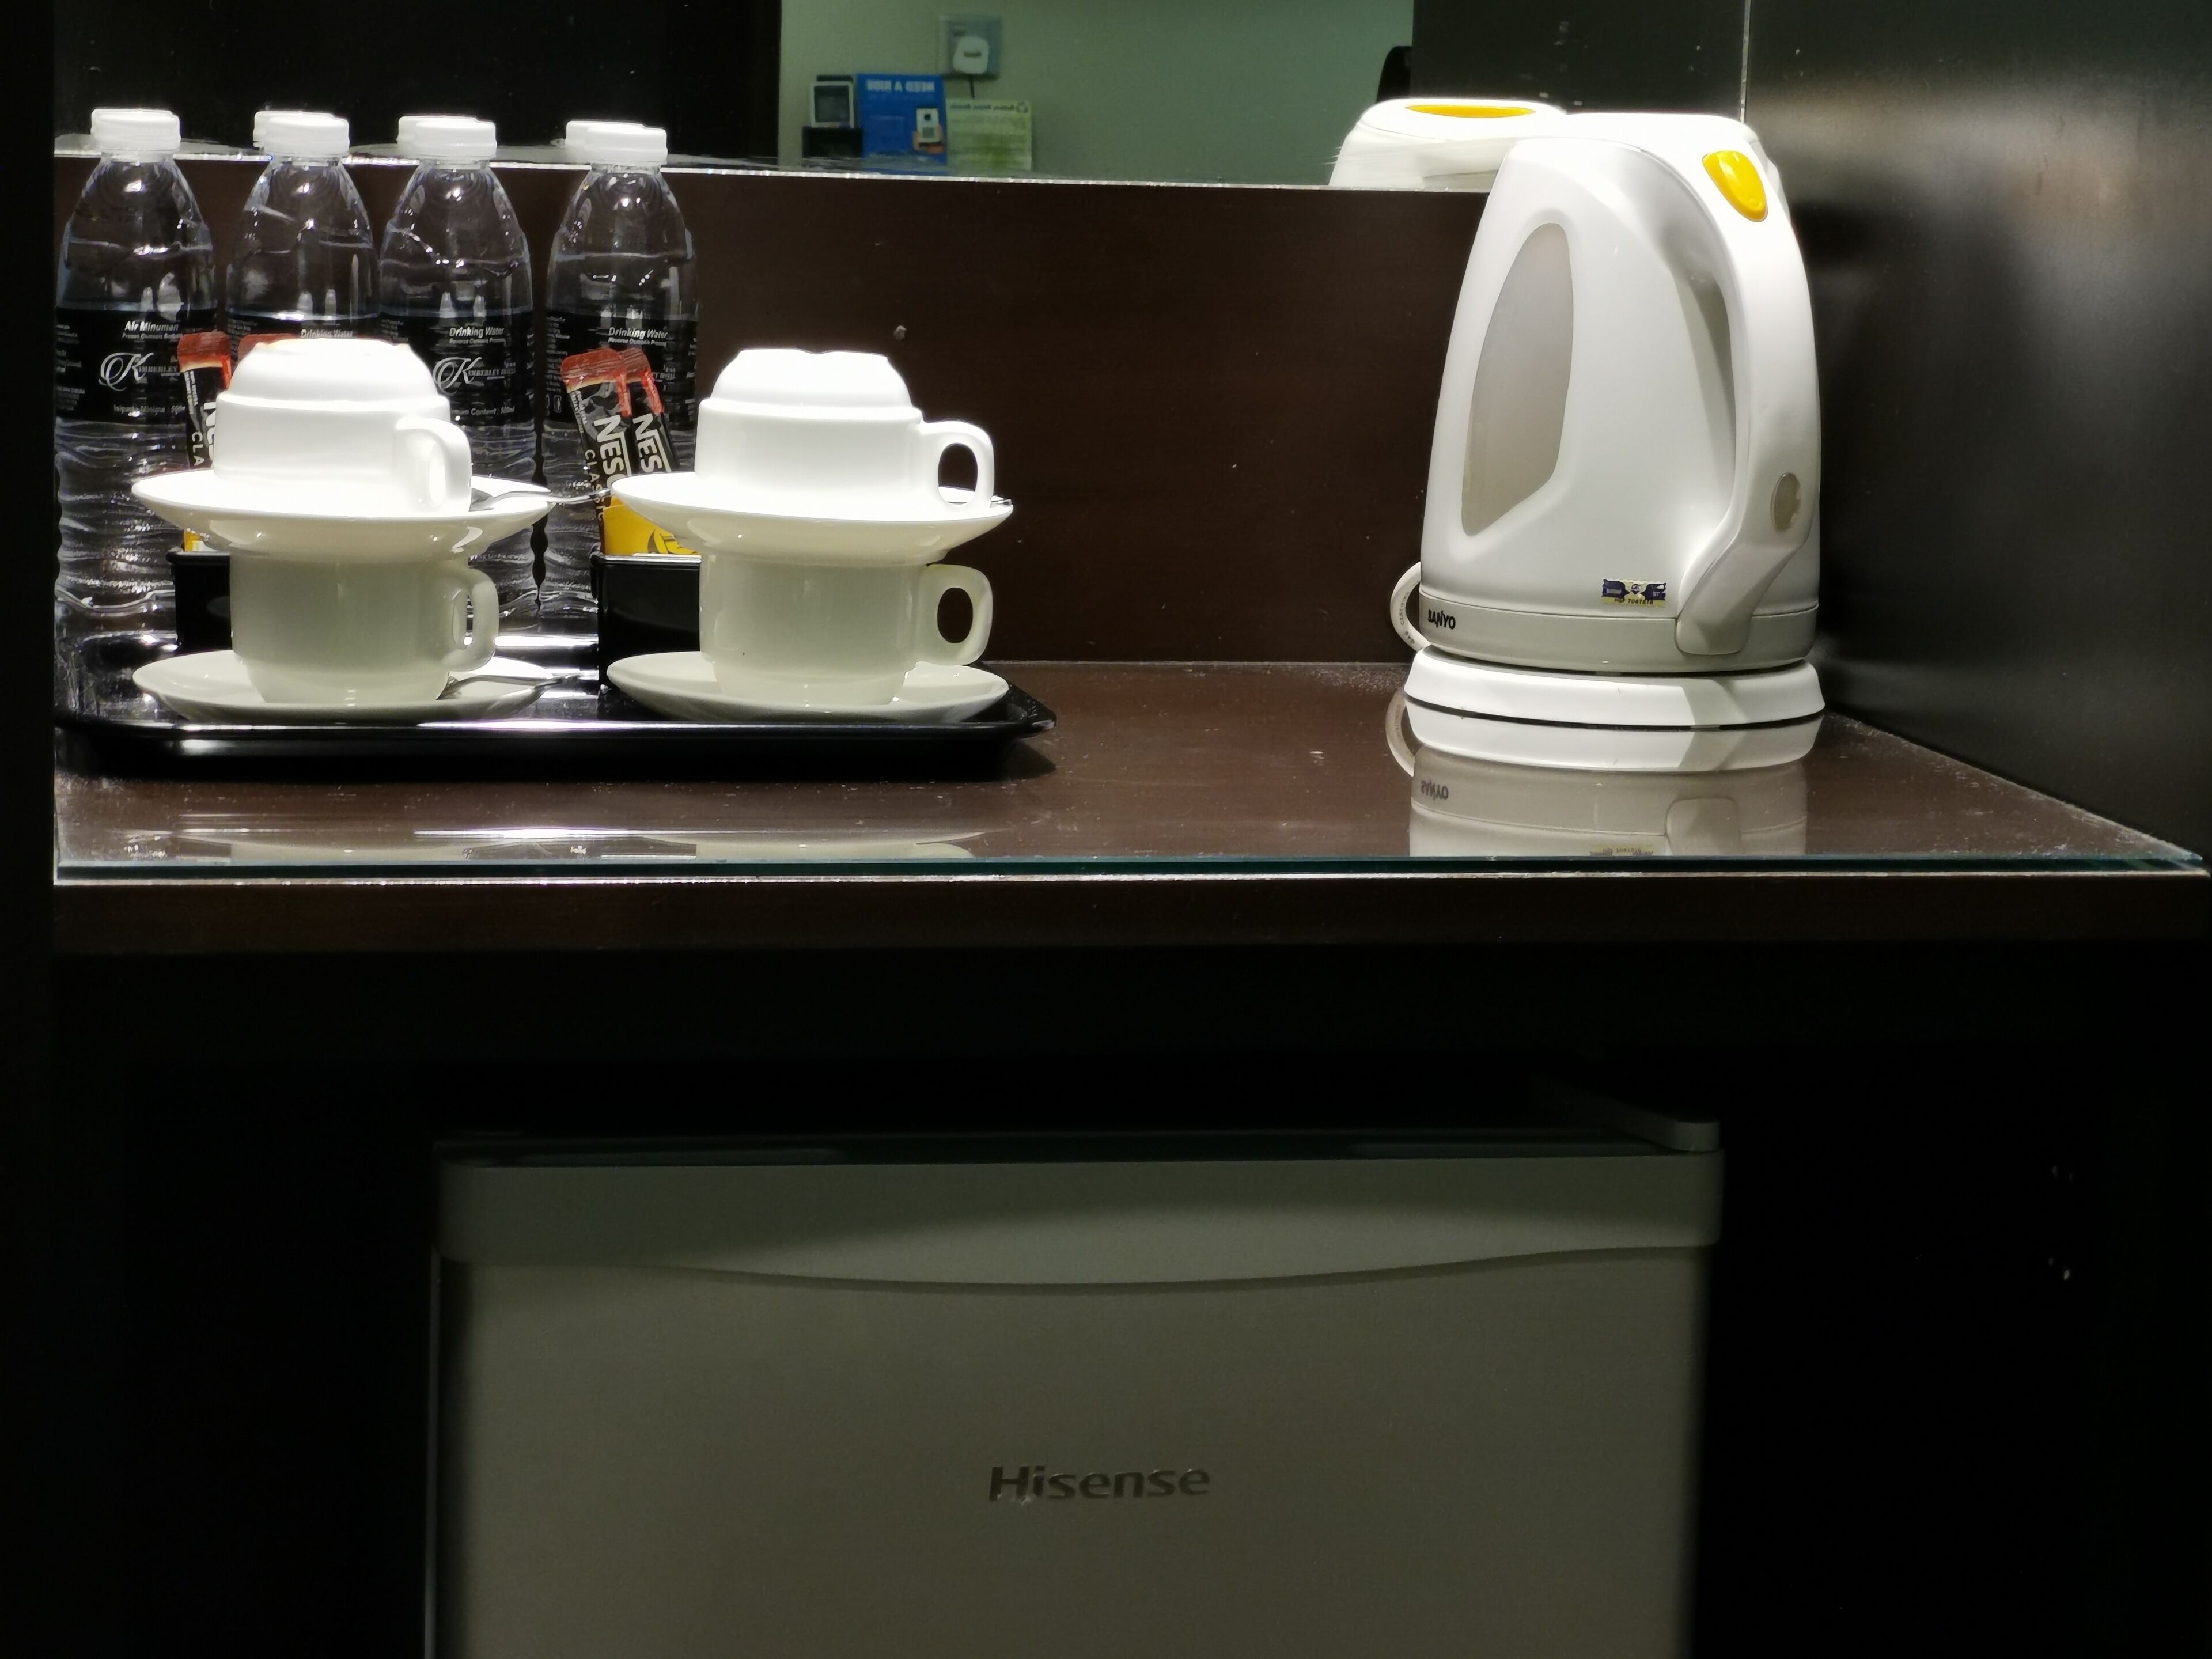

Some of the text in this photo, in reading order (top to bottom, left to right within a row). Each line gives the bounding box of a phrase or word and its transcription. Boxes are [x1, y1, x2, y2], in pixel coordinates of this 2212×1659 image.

[124, 321, 139, 331] Air
[449, 327, 505, 339] Drinking Water
[608, 327, 668, 340] Drinking Water
[1427, 609, 1456, 630] SANYO
[990, 1465, 1210, 1501] Hisense
